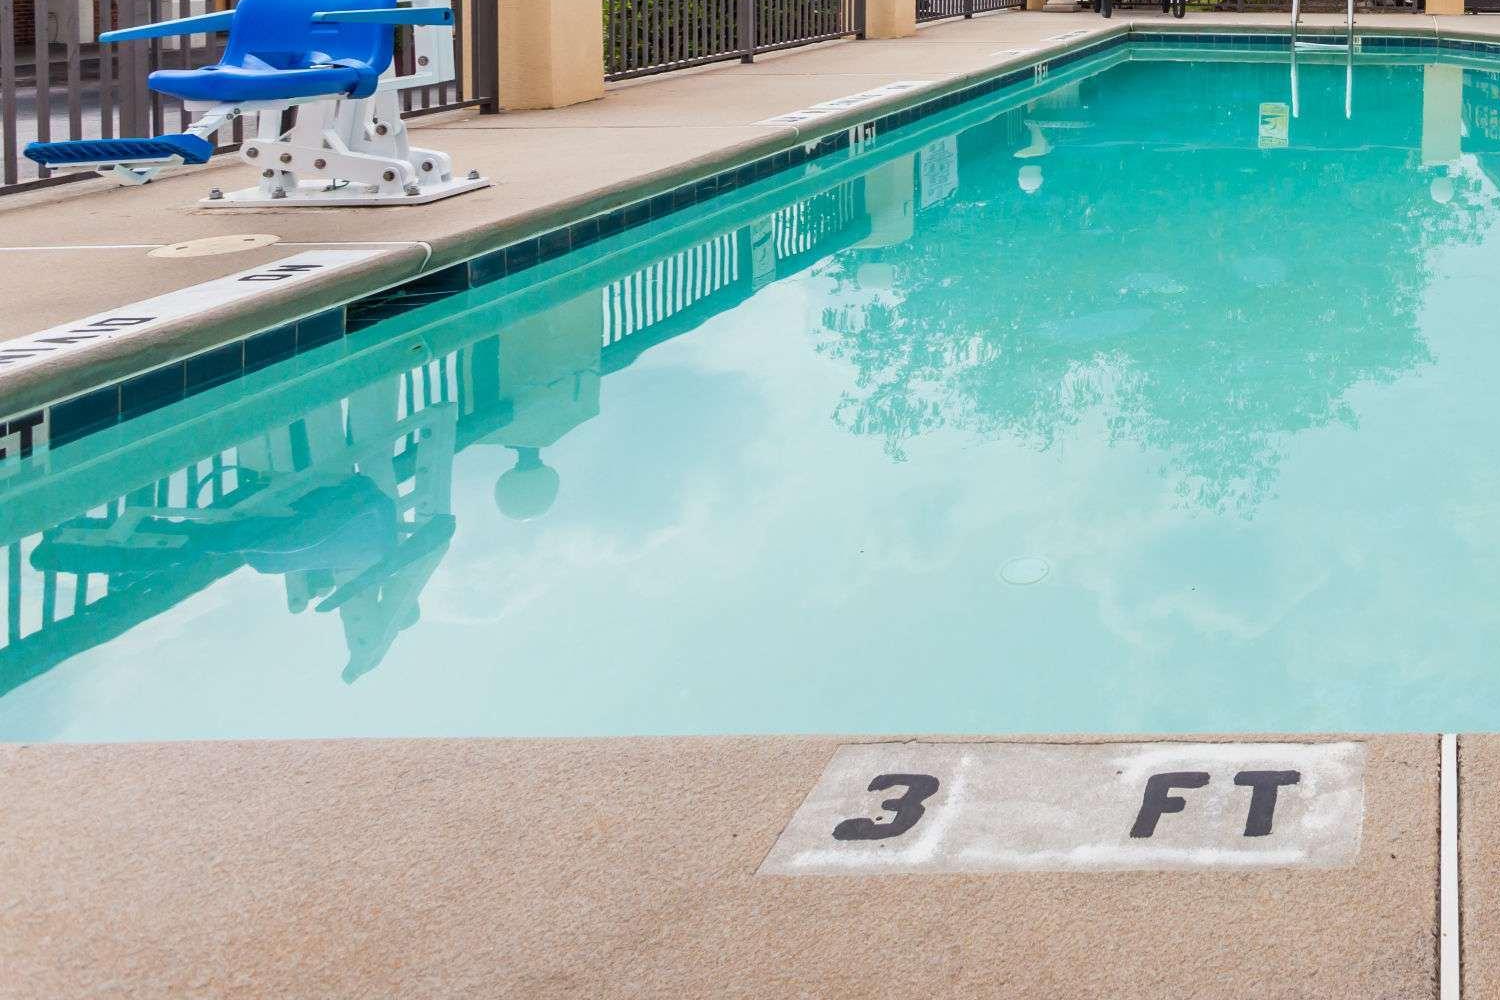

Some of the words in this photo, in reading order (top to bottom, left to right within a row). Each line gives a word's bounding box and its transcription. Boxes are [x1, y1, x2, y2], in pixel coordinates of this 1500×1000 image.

[237, 264, 324, 282] NO
[832, 773, 940, 841] 3
[1129, 770, 1301, 839] FT
